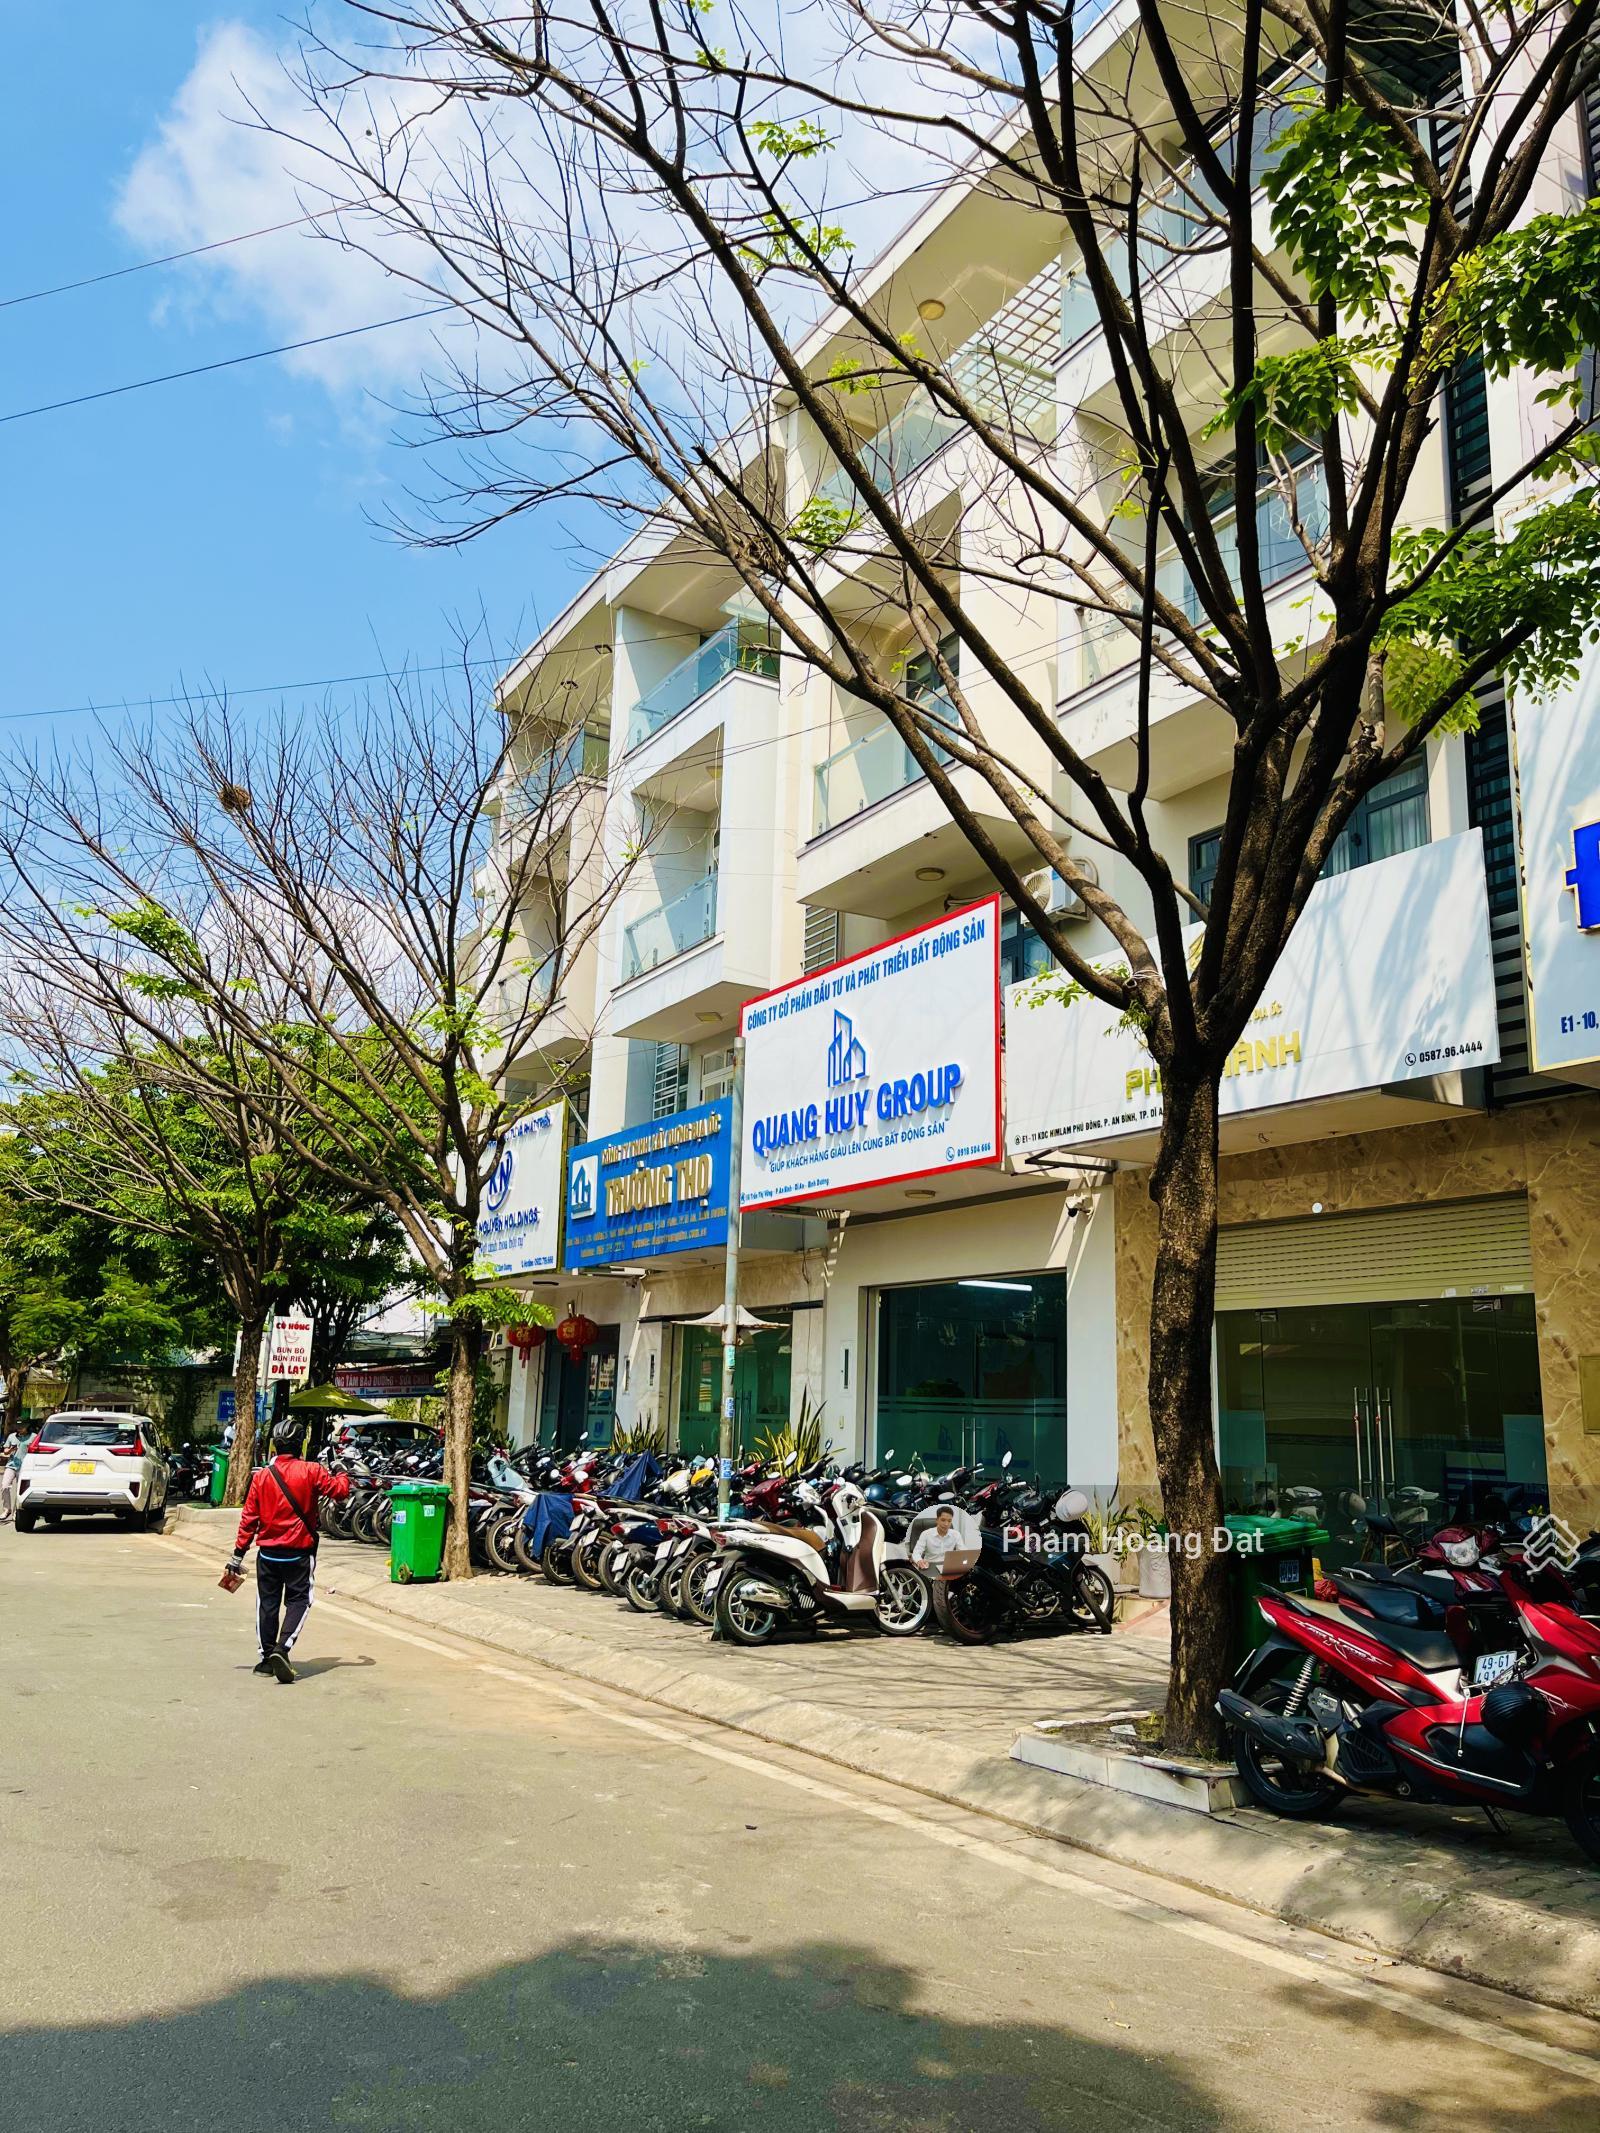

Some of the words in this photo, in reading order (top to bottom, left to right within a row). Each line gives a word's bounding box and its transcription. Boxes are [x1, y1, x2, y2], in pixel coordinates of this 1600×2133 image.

[747, 1007, 766, 1030] CÔNG
[768, 1004, 778, 1022] TY
[778, 993, 790, 1019] CỔ
[790, 986, 812, 1015] PHẦN
[814, 979, 830, 1006] ĐẦU
[832, 976, 844, 1000] TƯ
[845, 972, 857, 993] VÀ
[858, 962, 880, 988] PHÁT
[882, 945, 909, 976] TRIỂN
[912, 936, 930, 966] BẤT
[932, 930, 960, 958] ĐỘNG
[962, 917, 985, 945] SẢN
[1420, 1040, 1482, 1063] 0587.96.4444
[752, 1103, 820, 1158] QUANG
[825, 1089, 870, 1134] HUY
[876, 1064, 964, 1122] GROUP
[1038, 1130, 1048, 1140] KDC
[1050, 1125, 1072, 1138] HIMLAM
[1112, 1116, 1120, 1125] AN
[1140, 1110, 1148, 1120] TP.
[786, 1152, 808, 1170] KHÁCH
[809, 1146, 829, 1166] HÀNG
[830, 1143, 847, 1162] GIÀU
[848, 1138, 862, 1158] LÊN
[862, 1133, 883, 1154] CÙNG
[884, 1128, 899, 1148] BẤT
[900, 1125, 925, 1144] ĐỘNG
[605, 1160, 673, 1216] TRƯỜNG
[676, 1154, 713, 1206] THỌ
[504, 1207, 538, 1228] HOLDINGS
[272, 1362, 284, 1374] ĐÀ
[1482, 1654, 1510, 1670] 49-G1
